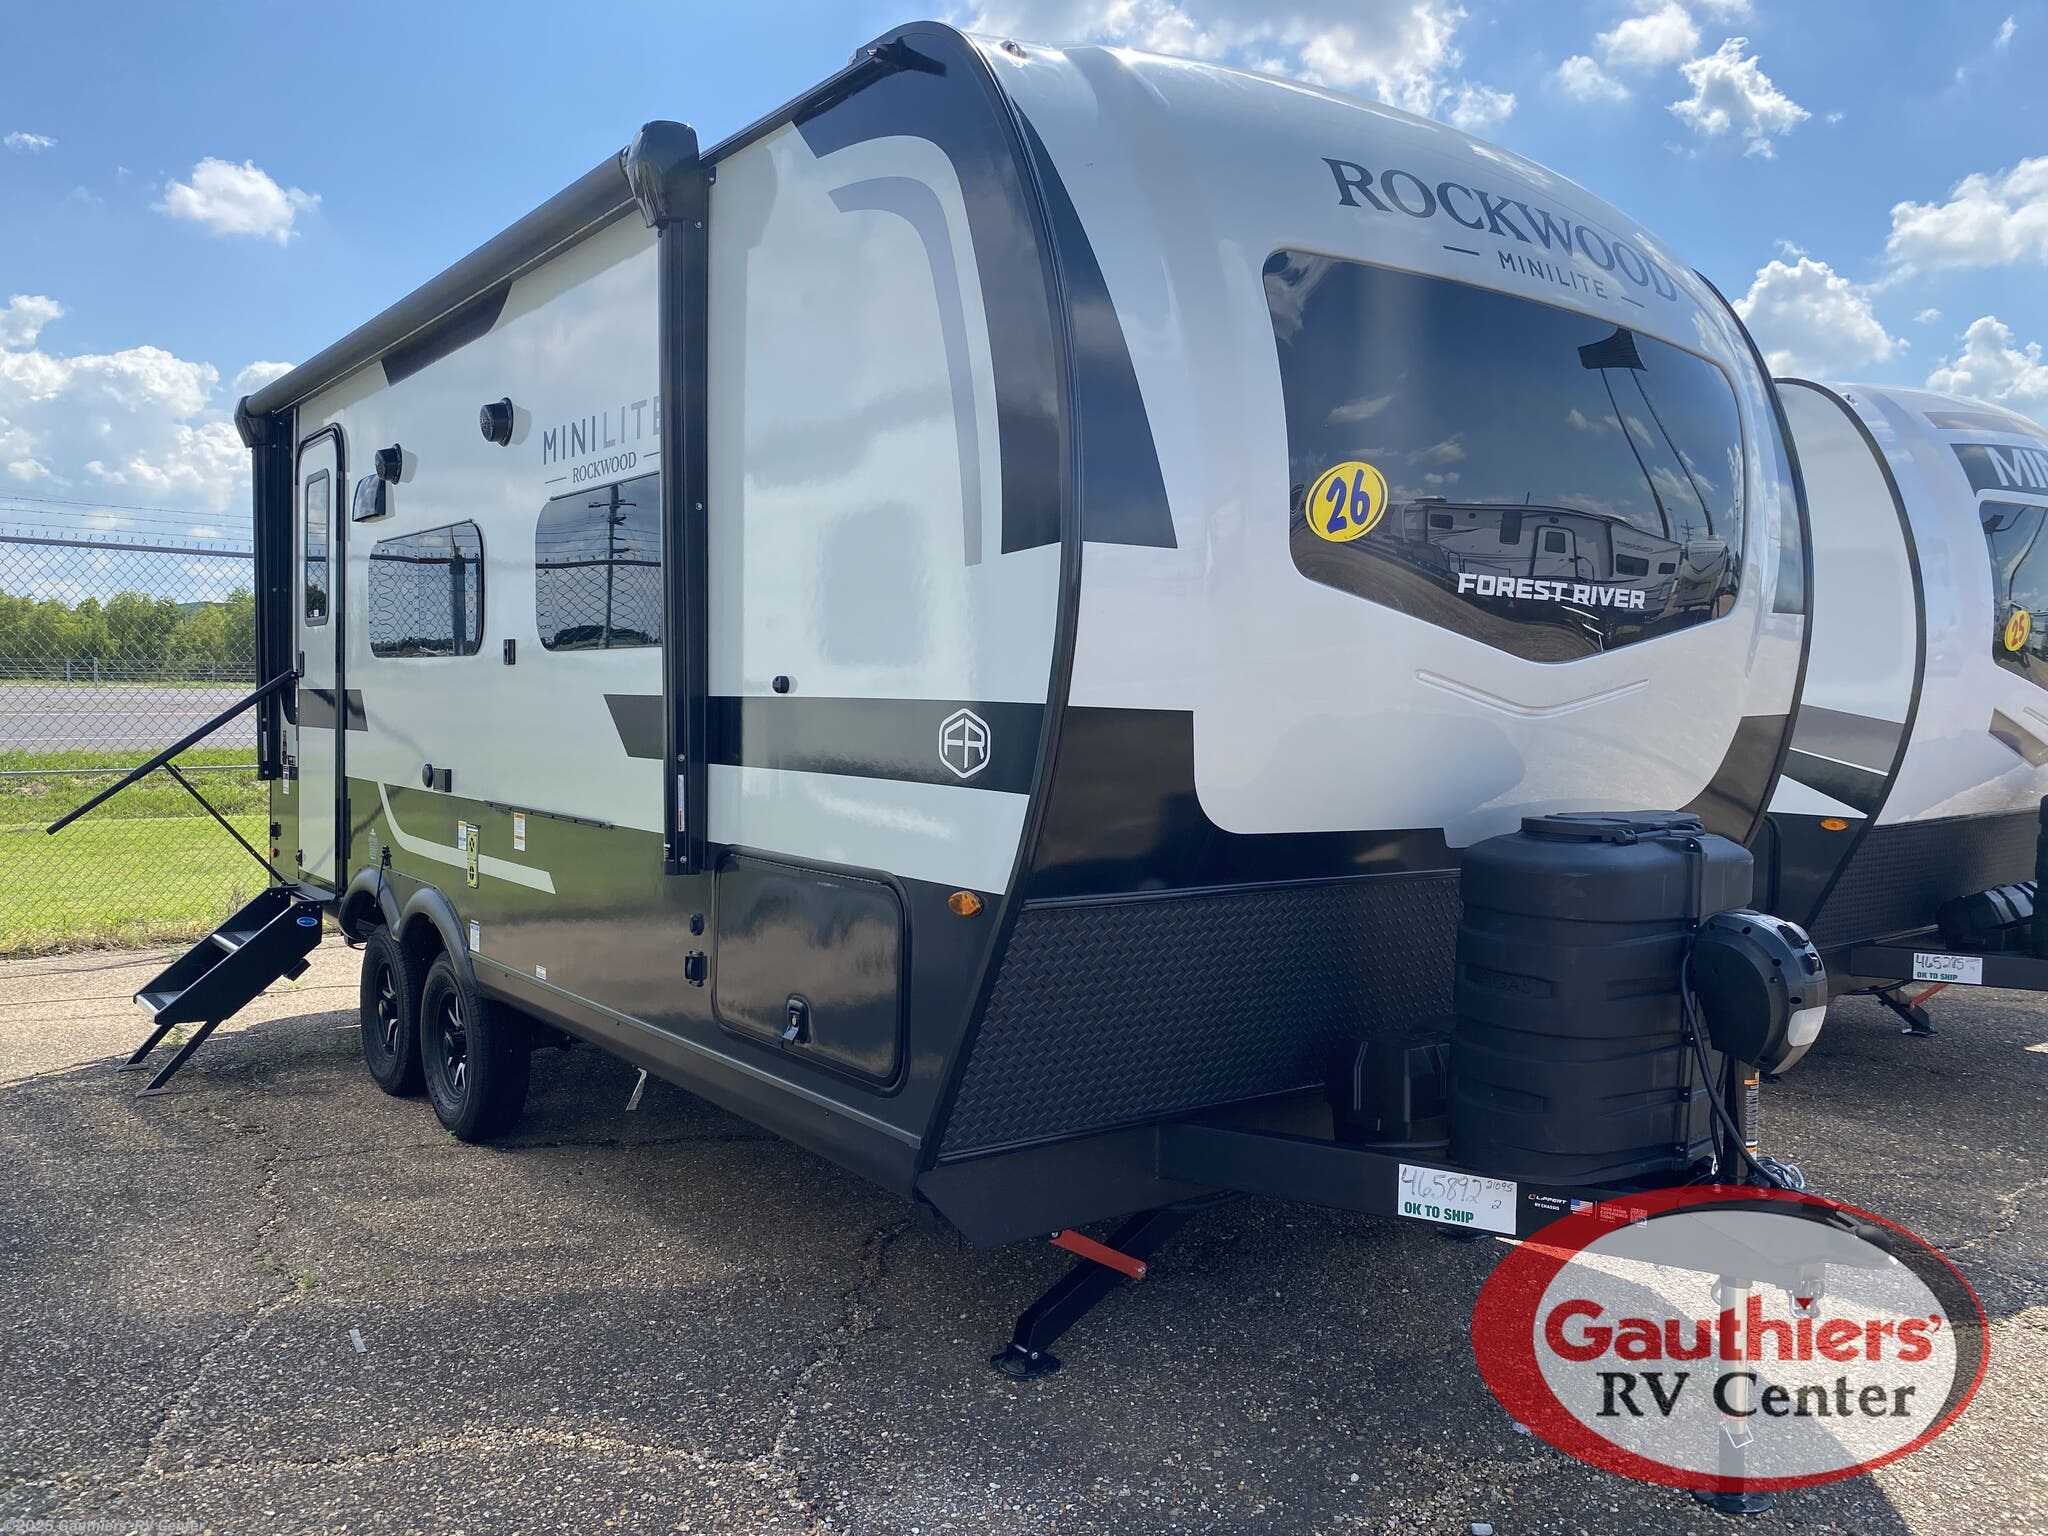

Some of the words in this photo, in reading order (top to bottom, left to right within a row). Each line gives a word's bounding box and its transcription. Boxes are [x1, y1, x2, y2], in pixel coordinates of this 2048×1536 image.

[1320, 157, 1677, 302] ROCKWOOD
[1497, 251, 1607, 300] MINILITE
[572, 451, 637, 483] ROCKWOOD
[1325, 469, 1371, 532] 26
[1457, 572, 1568, 603] FOREST
[1573, 584, 1646, 609] RIVER
[2010, 615, 2027, 647] 25
[1401, 1167, 1482, 1203] 465892
[1404, 1201, 1422, 1215] OK
[1424, 1205, 1440, 1218] TO
[1443, 1208, 1474, 1223] SHIP
